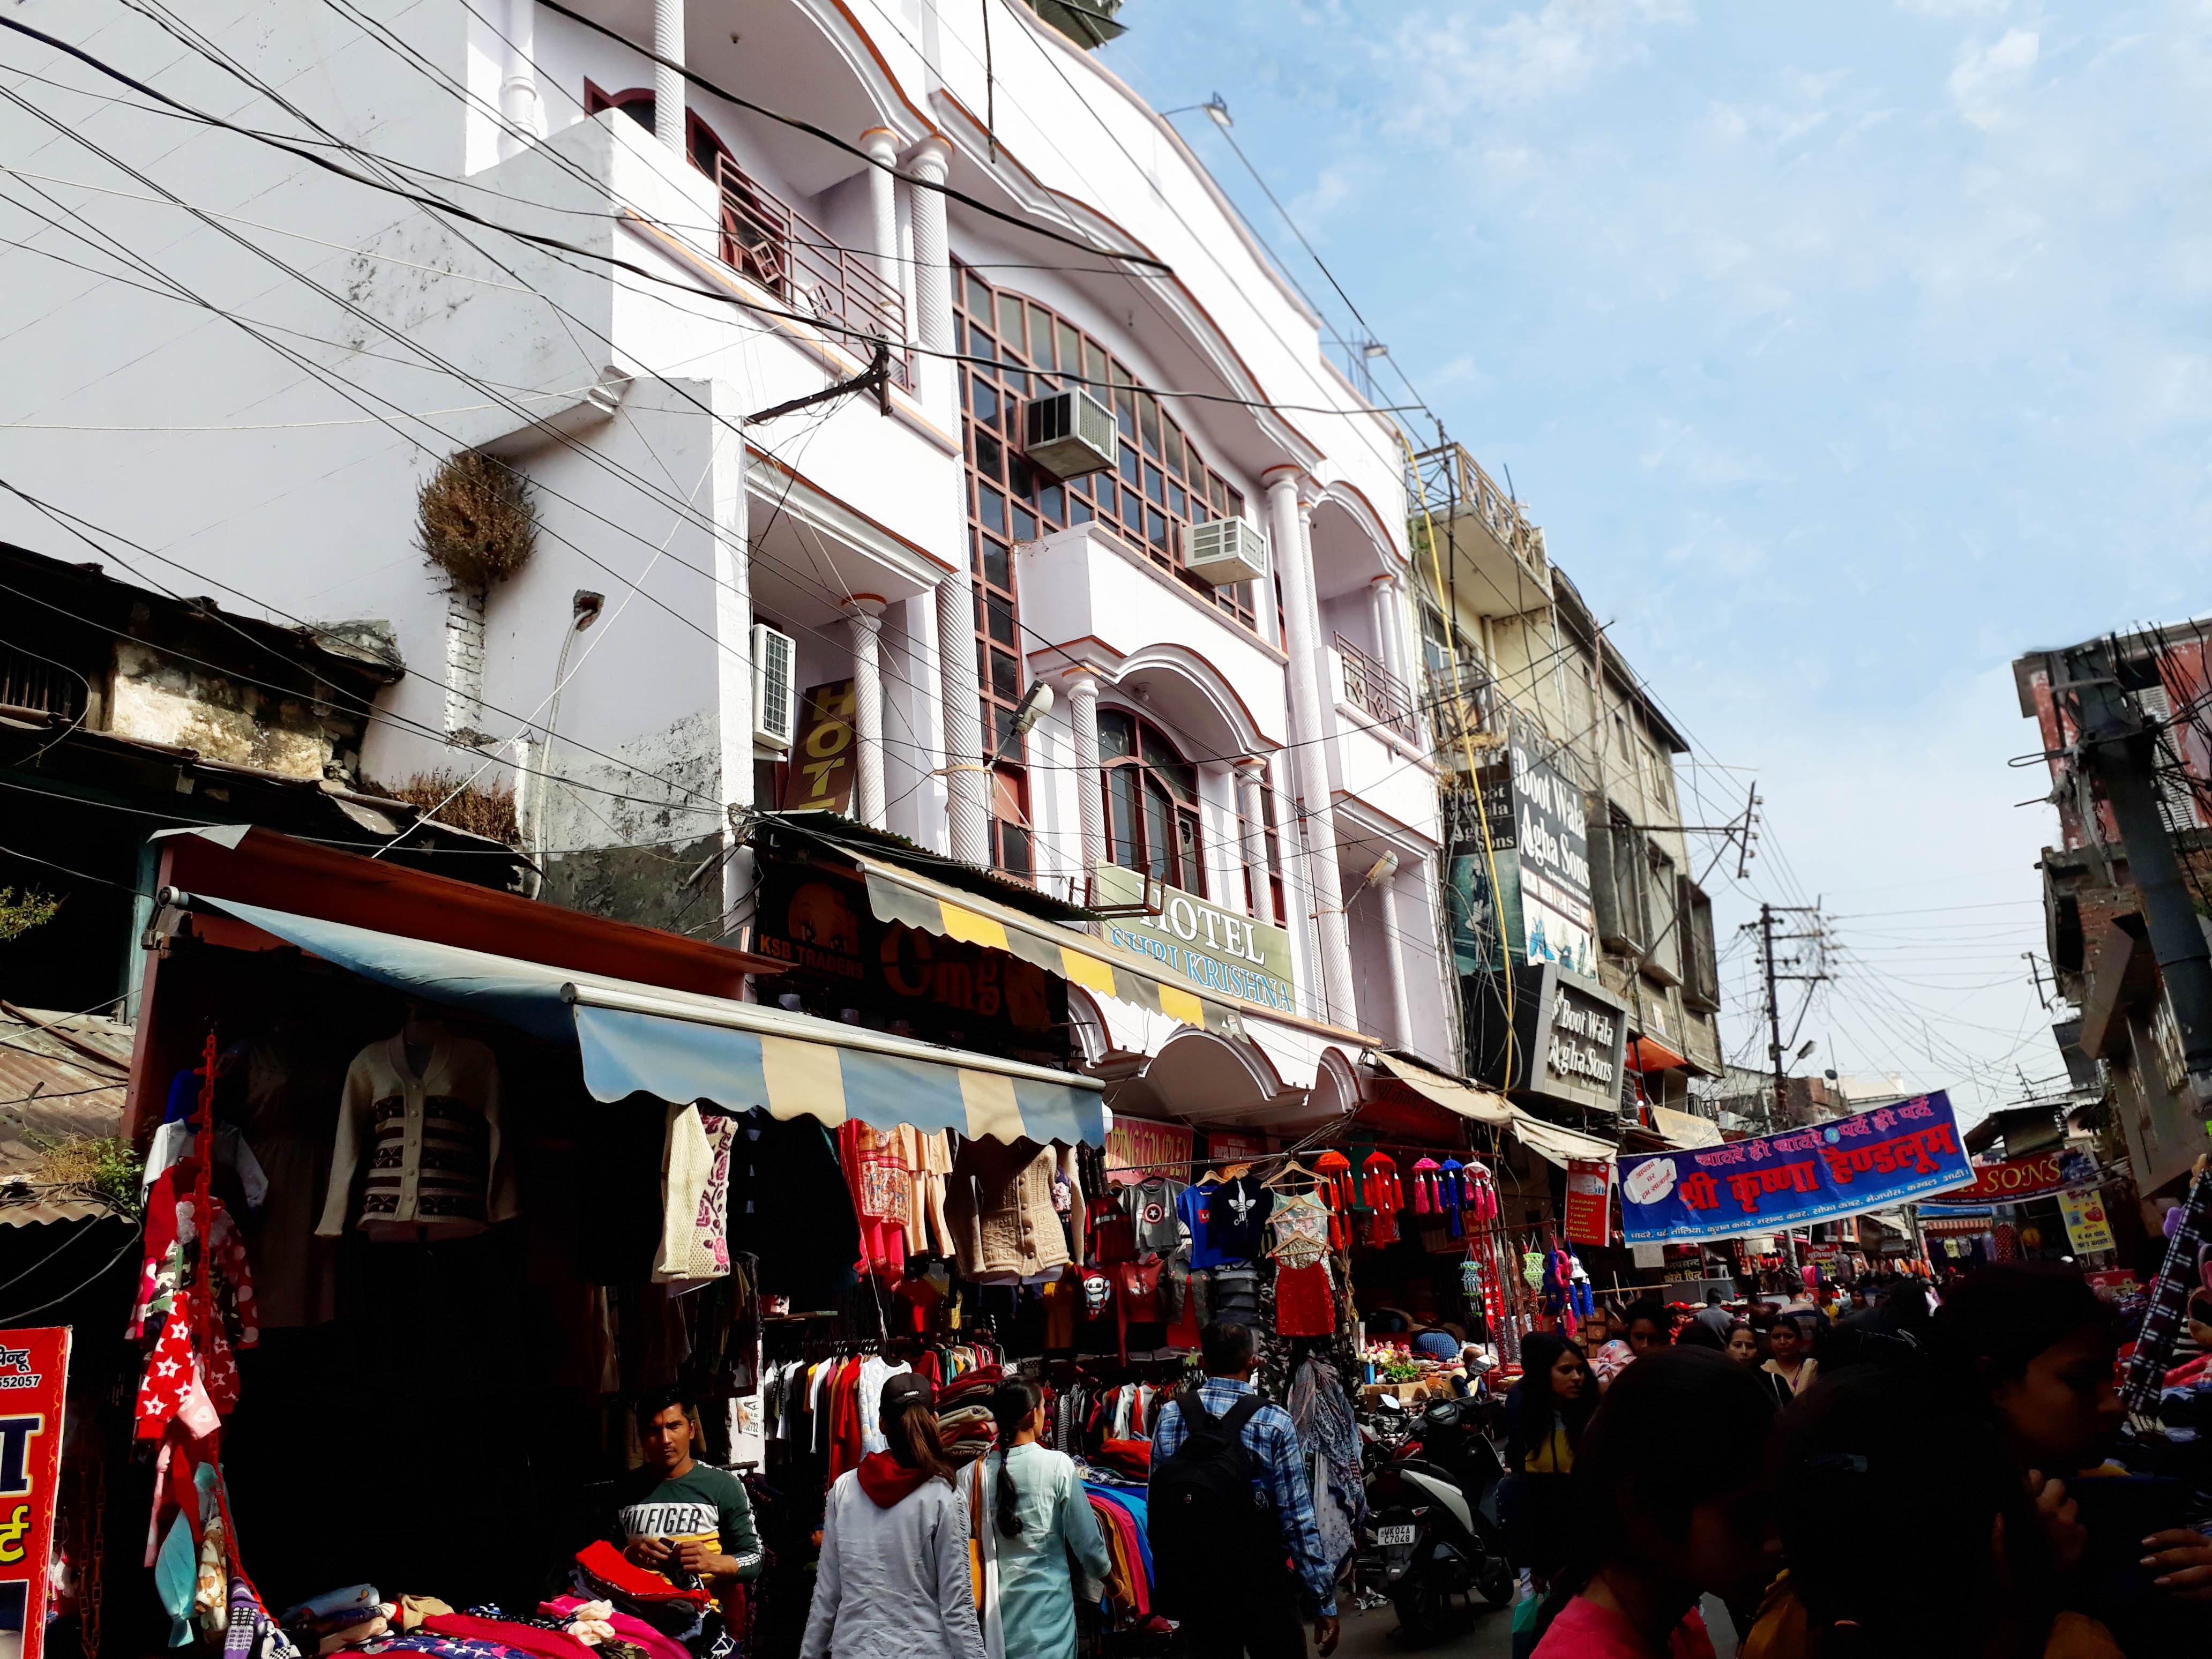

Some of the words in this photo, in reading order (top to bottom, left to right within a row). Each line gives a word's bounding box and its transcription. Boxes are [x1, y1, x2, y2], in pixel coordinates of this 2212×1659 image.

[799, 682, 855, 810] HOT
[1517, 746, 1552, 815] Boot
[1552, 776, 1587, 841] Wala
[1520, 803, 1559, 868] Agha
[1560, 833, 1590, 890] Sons
[1136, 881, 1265, 966] HOTEL
[760, 934, 791, 958] KSB
[796, 946, 864, 980] TRADERS
[1183, 950, 1294, 1014] KRISHNA
[1561, 999, 1586, 1035] Boot
[1588, 1010, 1613, 1047] Wala
[1548, 1035, 1586, 1075] Agha
[1586, 1048, 1613, 1082] Sons
[1748, 1139, 1772, 1161] ही
[1872, 1108, 1898, 1132] ही
[1679, 1171, 1720, 1211] श्री
[1727, 1160, 1820, 1213] कृष्णा
[1984, 1158, 2061, 1192] SONS
[622, 1508, 701, 1535] HILFIGER
